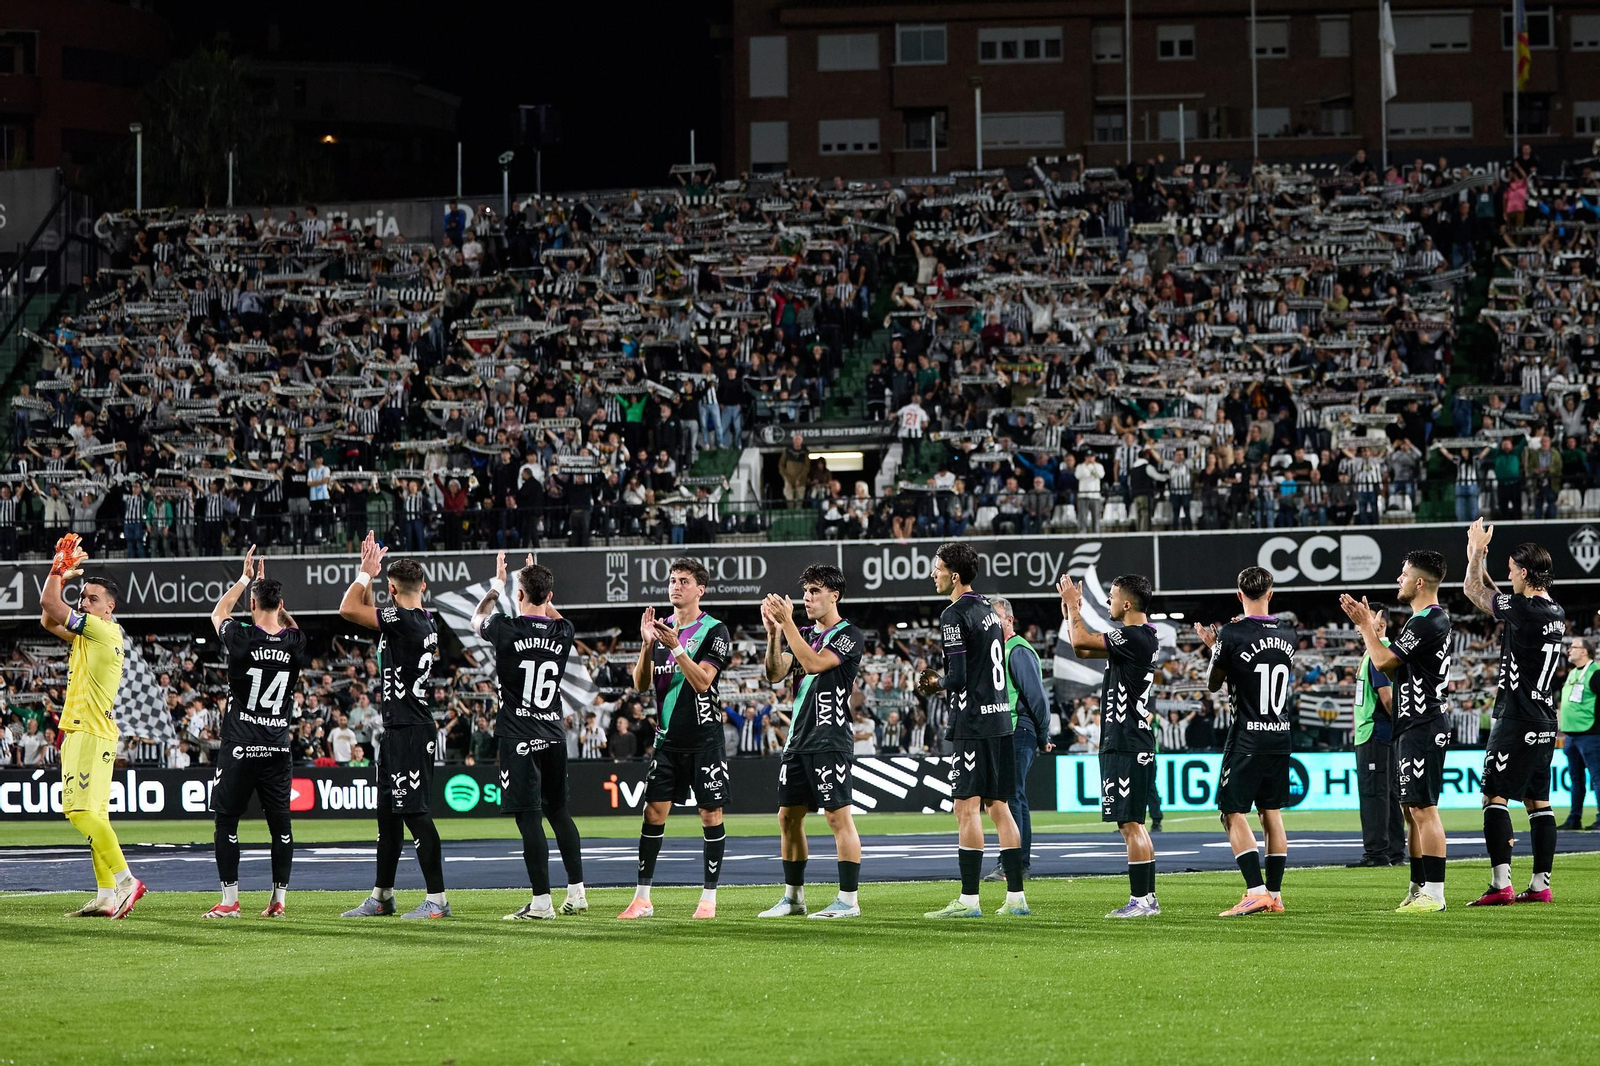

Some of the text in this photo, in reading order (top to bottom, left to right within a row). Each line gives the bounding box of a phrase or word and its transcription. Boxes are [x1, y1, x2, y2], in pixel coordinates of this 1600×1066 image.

[905, 412, 918, 426] 21
[635, 555, 768, 582] TOECID
[1257, 534, 1382, 583] CCD
[641, 587, 649, 595] A
[717, 584, 761, 595] Company
[251, 647, 291, 664] VÍCTOR
[514, 637, 563, 655] MURILLO
[412, 652, 434, 698] 2
[991, 639, 1006, 691] 8
[246, 667, 290, 715] 14
[519, 660, 559, 709] 16
[1254, 663, 1289, 717] 10
[1400, 683, 1411, 718] UAX
[818, 692, 833, 726] UAX
[704, 780, 723, 789] MGS
